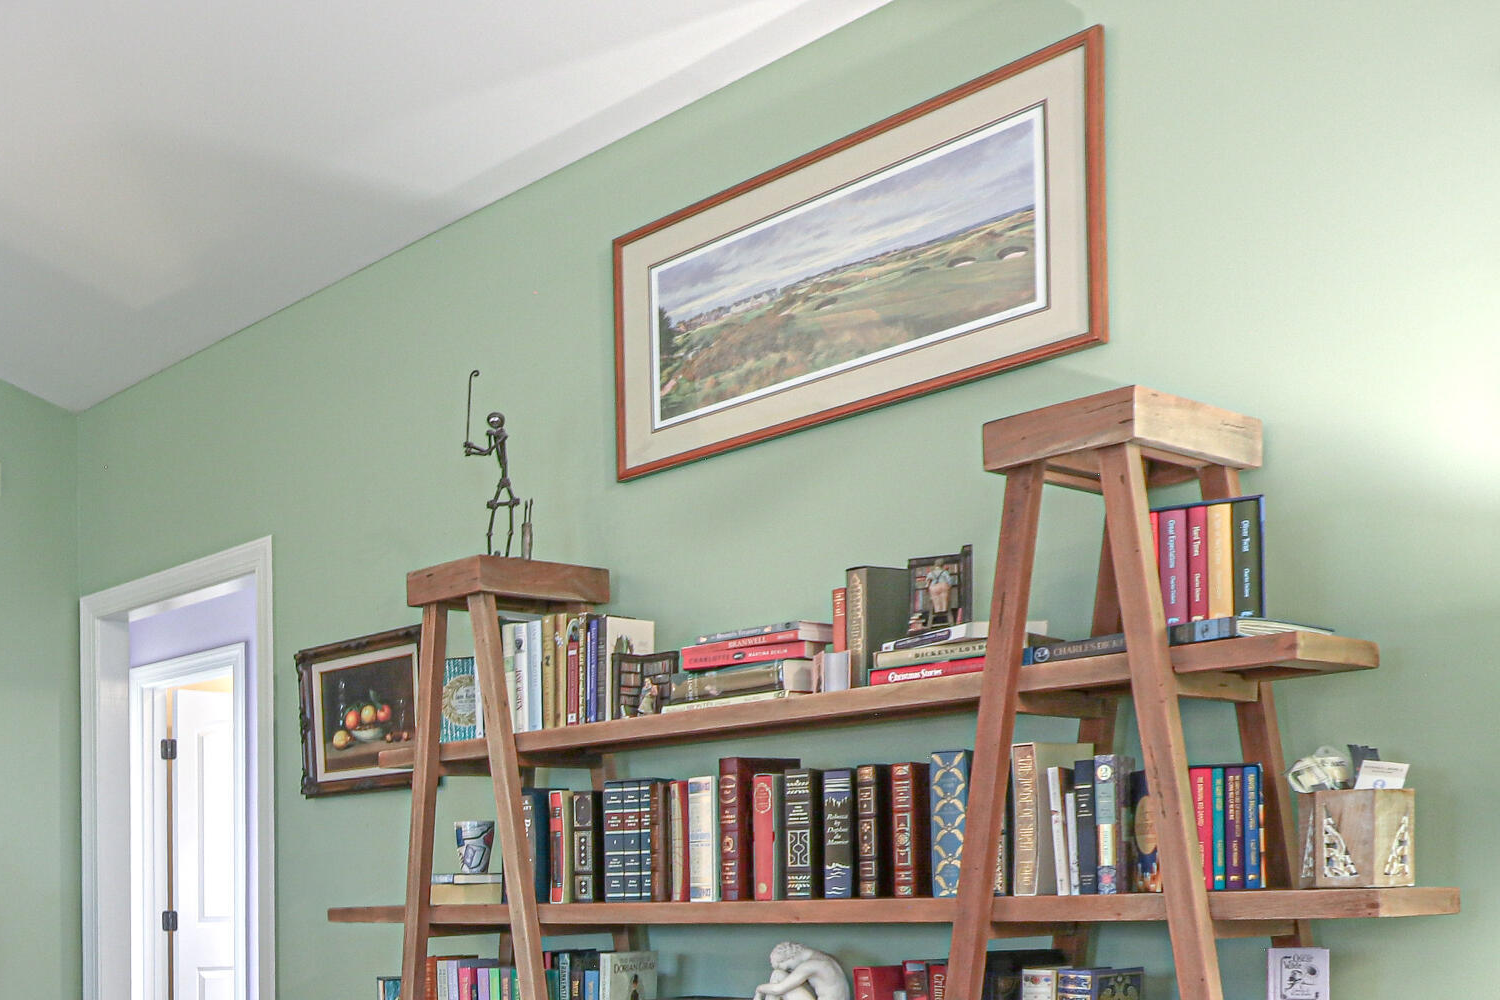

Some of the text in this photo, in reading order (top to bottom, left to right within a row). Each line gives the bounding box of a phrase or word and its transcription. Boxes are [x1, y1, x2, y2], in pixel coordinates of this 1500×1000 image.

[728, 636, 767, 648] BRANWELL
[1053, 642, 1097, 656] CHARLES
[688, 653, 731, 664] CHARLOTTE
[888, 668, 943, 683] Christmas Stories
[613, 963, 637, 975] DORIAN
